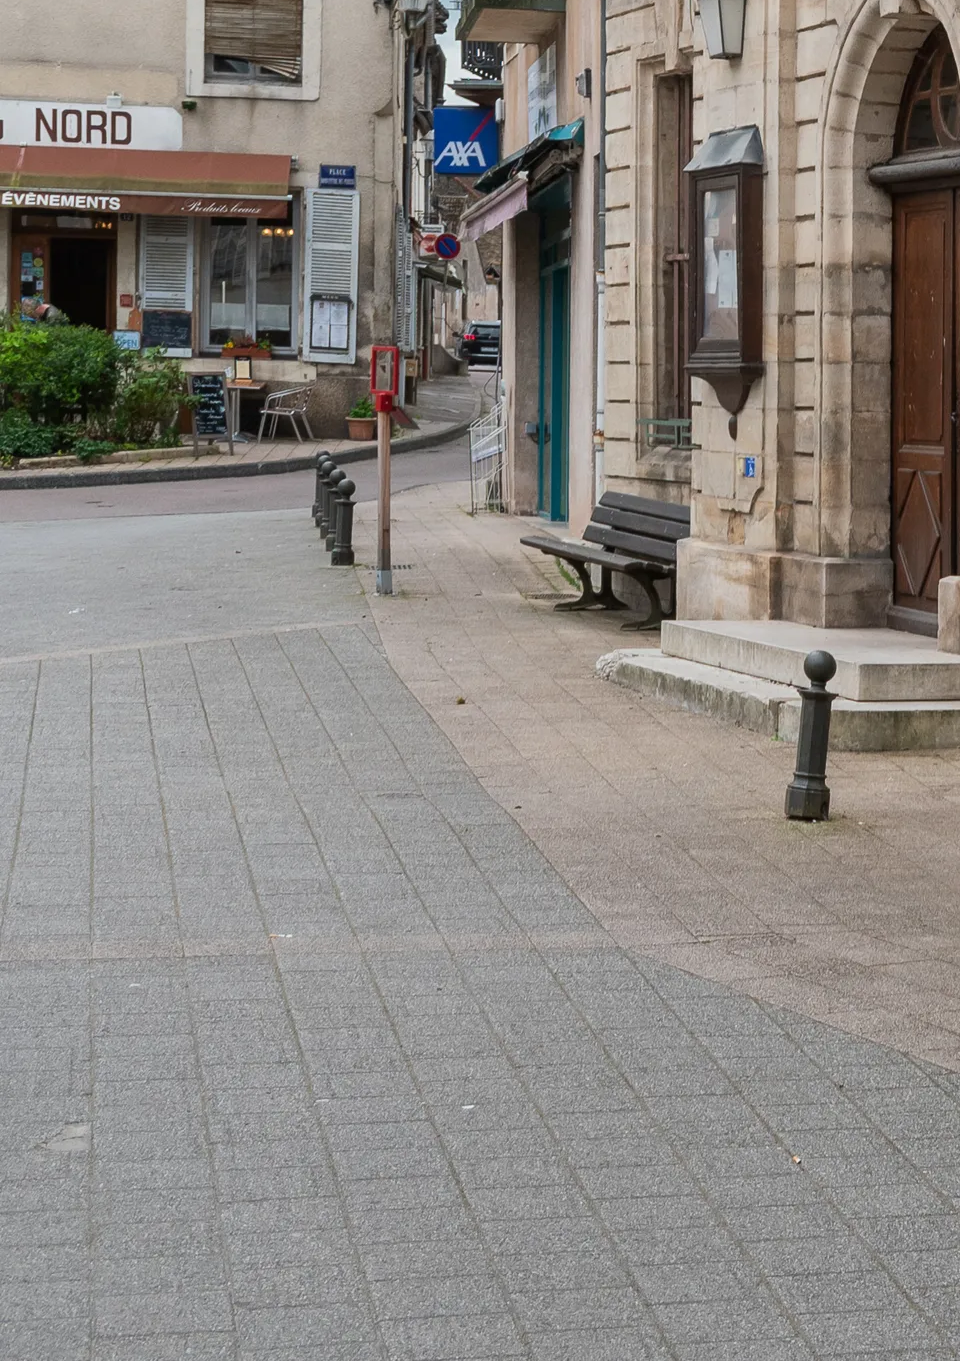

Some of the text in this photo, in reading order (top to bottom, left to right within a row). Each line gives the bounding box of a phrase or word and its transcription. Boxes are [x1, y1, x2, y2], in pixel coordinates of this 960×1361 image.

[35, 107, 132, 145] NORD
[434, 141, 487, 167] AXA
[180, 197, 263, 214] Produits locaux
